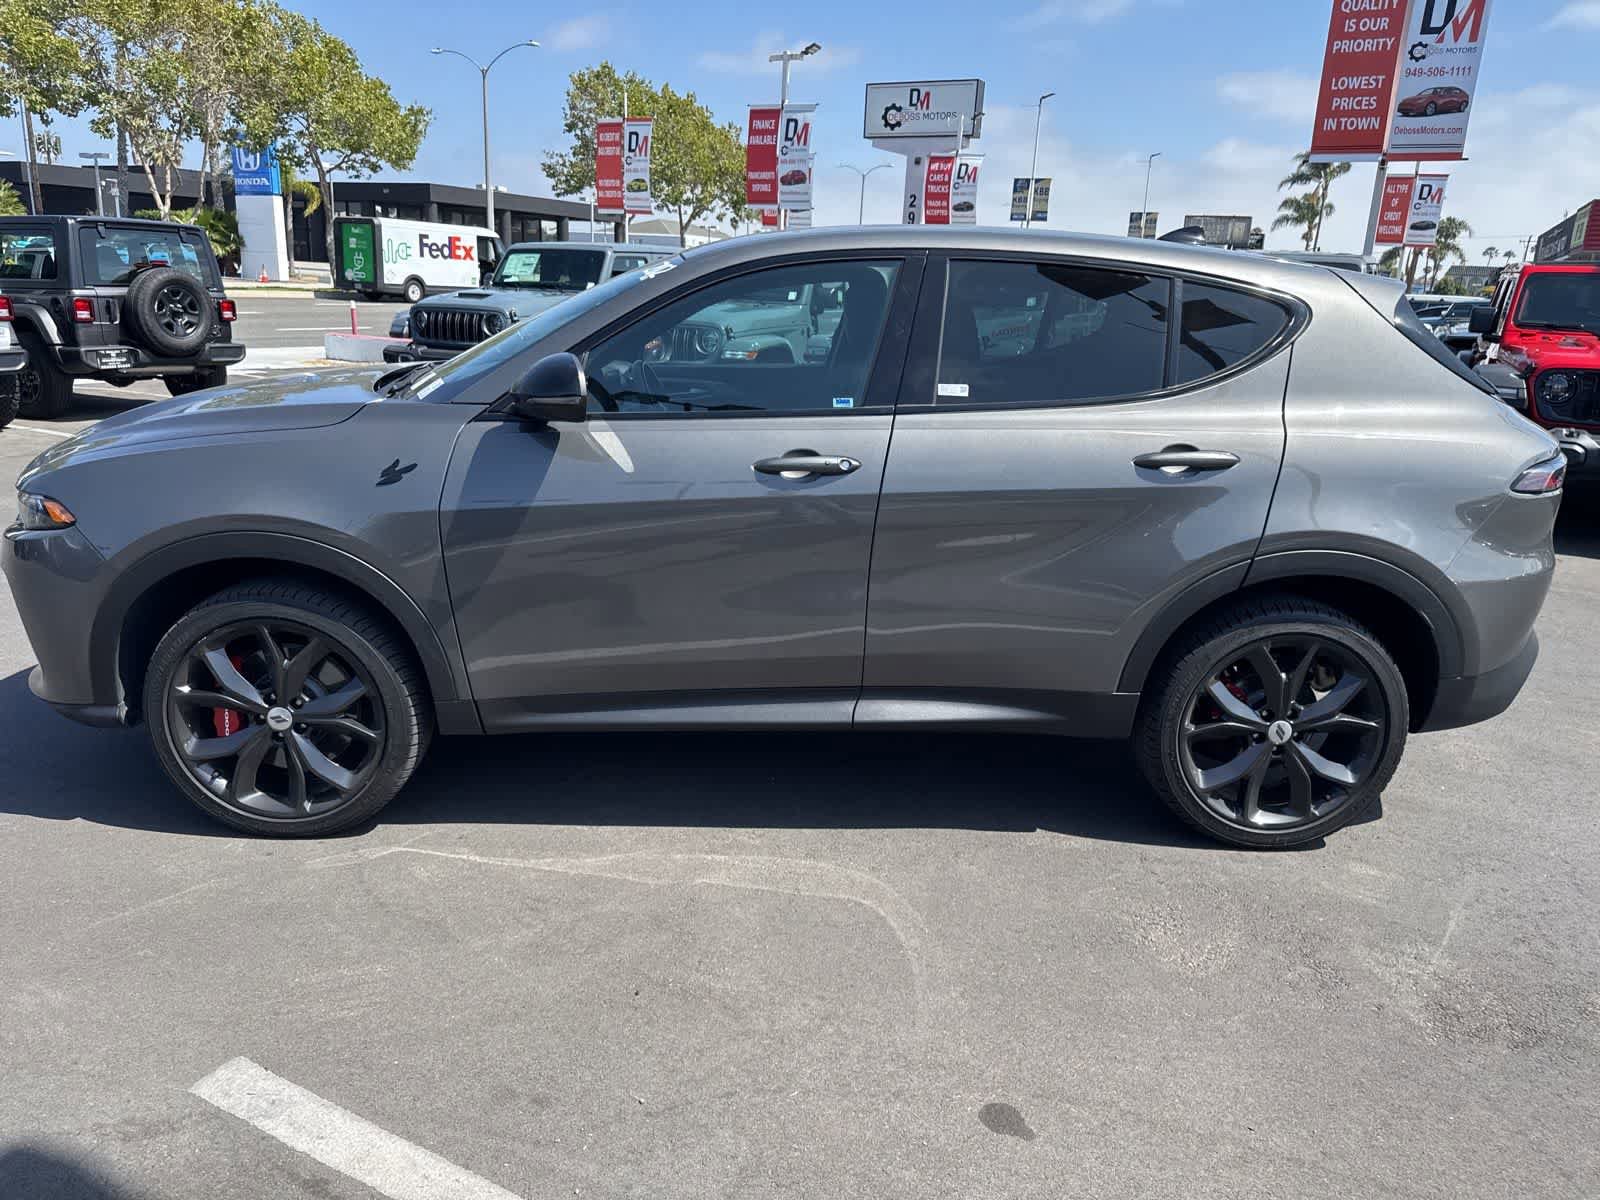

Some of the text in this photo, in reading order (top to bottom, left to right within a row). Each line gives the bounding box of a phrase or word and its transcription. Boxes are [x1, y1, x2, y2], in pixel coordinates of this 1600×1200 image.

[1341, 0, 1398, 12] QUALITY
[1344, 17, 1389, 32] IS OUR
[1420, 0, 1486, 43] DM
[1333, 38, 1395, 54] PRIORITY
[1445, 47, 1478, 55] MOTORS
[1405, 67, 1472, 78] 949-506-1111
[1331, 75, 1385, 90] LOWEST
[909, 88, 931, 111] DM
[1331, 96, 1377, 110] PRICES
[922, 111, 958, 121] MOTORS
[752, 120, 776, 129] FINANCE
[1323, 117, 1380, 131] IN TOWN
[1394, 126, 1463, 136] DebossMotors.com
[785, 118, 810, 146] DM
[628, 131, 649, 157] DM
[749, 135, 777, 145] AVAILABLE
[929, 173, 943, 182] CARS
[957, 163, 978, 184] DM
[927, 185, 949, 193] TRUCKS
[1386, 183, 1409, 193] ALL TYPE
[1418, 184, 1444, 204] DM
[1391, 198, 1399, 207] OF
[418, 233, 474, 261] FedEx
